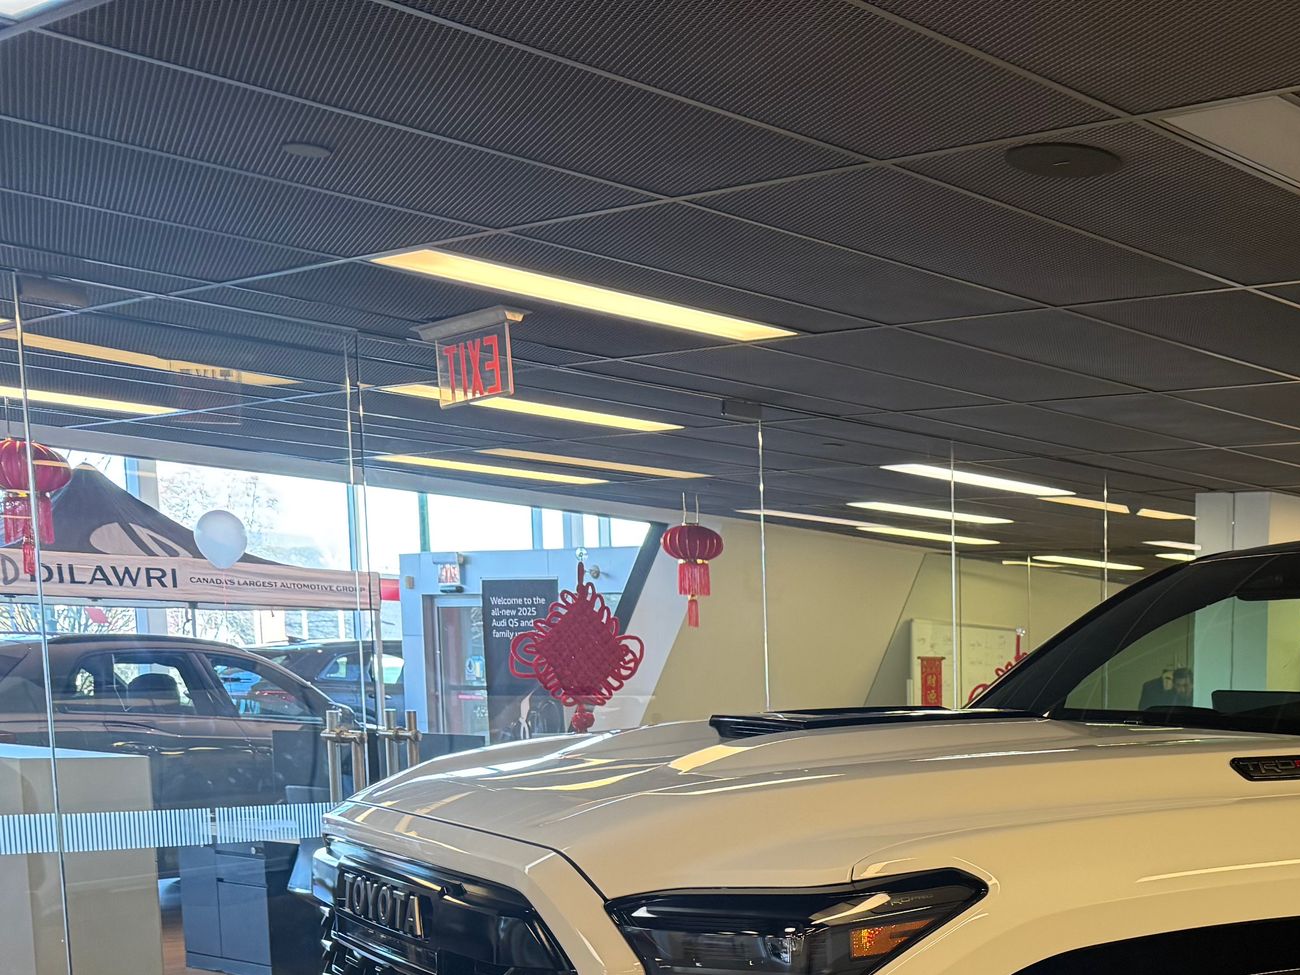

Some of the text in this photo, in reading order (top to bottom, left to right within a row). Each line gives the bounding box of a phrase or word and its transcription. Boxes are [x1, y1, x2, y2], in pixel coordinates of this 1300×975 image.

[237, 579, 278, 588] LARGEST
[280, 582, 334, 592] AUTOMOTIVE
[490, 596, 546, 605] Welcome to the
[491, 607, 537, 616] all-new 2025
[492, 619, 534, 628] Audi Q5 and
[493, 629, 514, 640] family
[1239, 760, 1296, 773] TRD
[343, 872, 425, 939] TOYOTA
